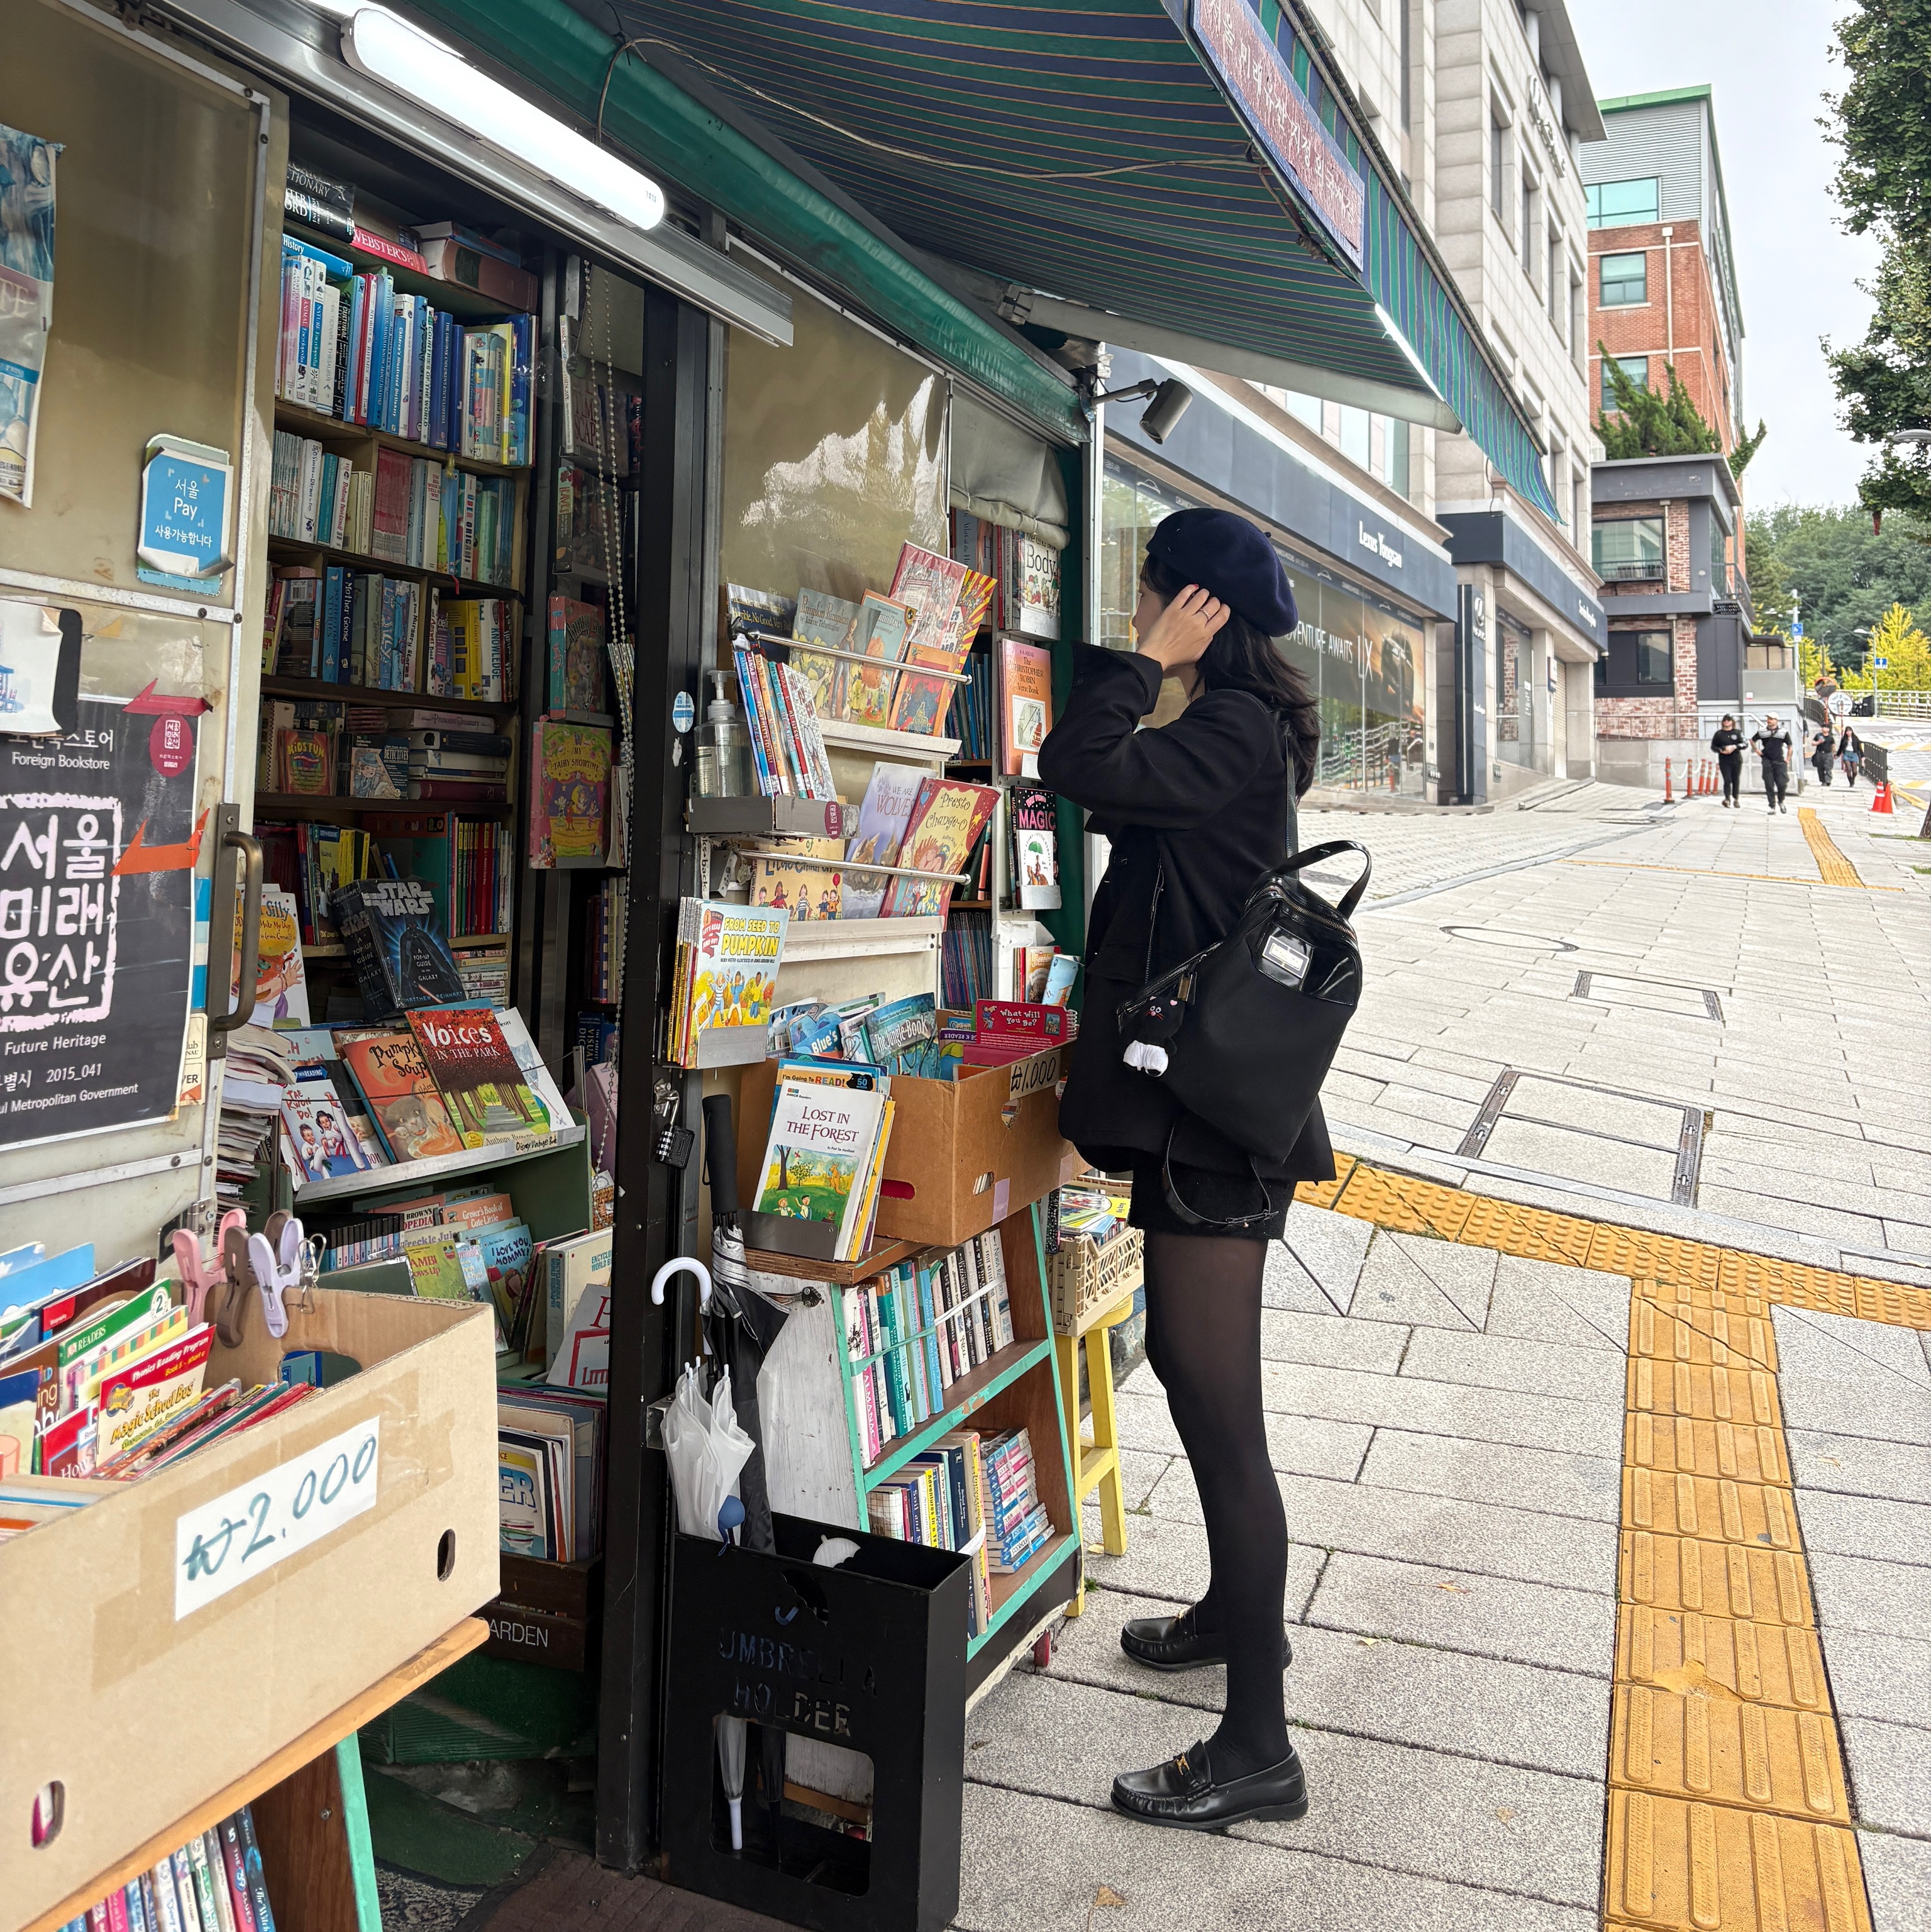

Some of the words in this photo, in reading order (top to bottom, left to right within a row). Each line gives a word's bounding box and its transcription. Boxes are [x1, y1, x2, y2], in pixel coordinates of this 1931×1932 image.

[283, 235, 304, 254] History
[175, 479, 199, 499] 서울
[174, 497, 198, 521] Pay
[155, 525, 213, 548] 사용가능합니다
[464, 522, 473, 563] ORIGAMI
[1359, 520, 1378, 553] Lexus
[1378, 532, 1402, 568] Yongsan
[1026, 544, 1056, 583] Body
[343, 582, 352, 614] Mother
[752, 613, 760, 623] No
[760, 614, 773, 626] Good,
[800, 595, 825, 618] Pumpkin
[826, 602, 849, 625] Pumpkin
[343, 616, 351, 641] Goose
[407, 615, 418, 647] Nursery
[492, 628, 501, 679] KNOWLEDGE
[1023, 657, 1031, 665] The
[1329, 633, 1353, 664] AWAITS
[1358, 635, 1373, 682] UX
[1019, 674, 1036, 684] ROBIN
[11, 751, 55, 769] Foreign
[58, 753, 110, 770] Bookstore
[307, 743, 324, 758] FUN
[384, 749, 409, 760] DETECTIVES
[892, 786, 902, 795] WE
[903, 787, 914, 796] ARE
[939, 792, 971, 811] Presto
[926, 811, 968, 831] Change-O
[1018, 809, 1056, 831] MAGIC
[1, 814, 108, 880] 서울
[806, 841, 814, 850] of
[362, 882, 431, 899] STAR
[0, 882, 104, 939] 미래
[267, 901, 289, 921] Silly
[363, 897, 434, 916] WARS
[724, 917, 745, 932] FROM
[747, 918, 767, 933] SEED
[769, 921, 780, 933] TO
[721, 934, 780, 957] PUMPKIN
[357, 952, 374, 964] GUIDE
[0, 941, 101, 1008] 유산
[358, 968, 382, 983] GALAXY
[1000, 1009, 1022, 1017] What
[1022, 1019, 1037, 1027] Be?
[422, 1021, 493, 1047] Voices
[811, 1030, 838, 1053] Blue's
[874, 1033, 887, 1052] The
[887, 1024, 907, 1044] Jungle
[906, 1014, 928, 1038] Book
[4, 1037, 48, 1056] Future
[53, 1033, 106, 1050] Heritage
[435, 1050, 448, 1060] IN
[450, 1049, 472, 1058] THE
[473, 1047, 501, 1057] PARK
[585, 1029, 594, 1062] VISUAL
[45, 1063, 102, 1084] 2015_041
[392, 1058, 428, 1079] Soup
[792, 1075, 808, 1083] Going
[815, 1076, 846, 1087] READ!
[857, 1078, 868, 1086] 50
[11, 1092, 77, 1113] Metropolitan
[79, 1082, 139, 1103] Government
[287, 1089, 304, 1098] TAE
[802, 1106, 836, 1121] LOST
[837, 1112, 850, 1125] IN
[787, 1121, 809, 1135] THE
[810, 1123, 859, 1143] FOREST
[407, 1208, 432, 1220] BROWN'S
[462, 1207, 483, 1219] Grover's
[484, 1206, 498, 1214] Book
[498, 1202, 503, 1211] of
[471, 1218, 483, 1228] Cute
[484, 1214, 499, 1224] Little
[492, 1247, 494, 1257] I
[495, 1243, 513, 1256] LOVE
[495, 1248, 529, 1265] MOMMY!
[155, 1294, 163, 1313] 2
[77, 1325, 106, 1351] READERS
[132, 1368, 156, 1383] Phonics
[157, 1352, 182, 1368] Reading
[183, 1336, 209, 1355] Program
[165, 1367, 177, 1377] Book
[148, 1387, 160, 1402] The
[111, 1410, 144, 1445] Magic
[145, 1394, 175, 1423] School
[175, 1381, 194, 1403] Bus
[863, 1374, 876, 1439] ALMANAC
[241, 1891, 253, 1924] CLUES
